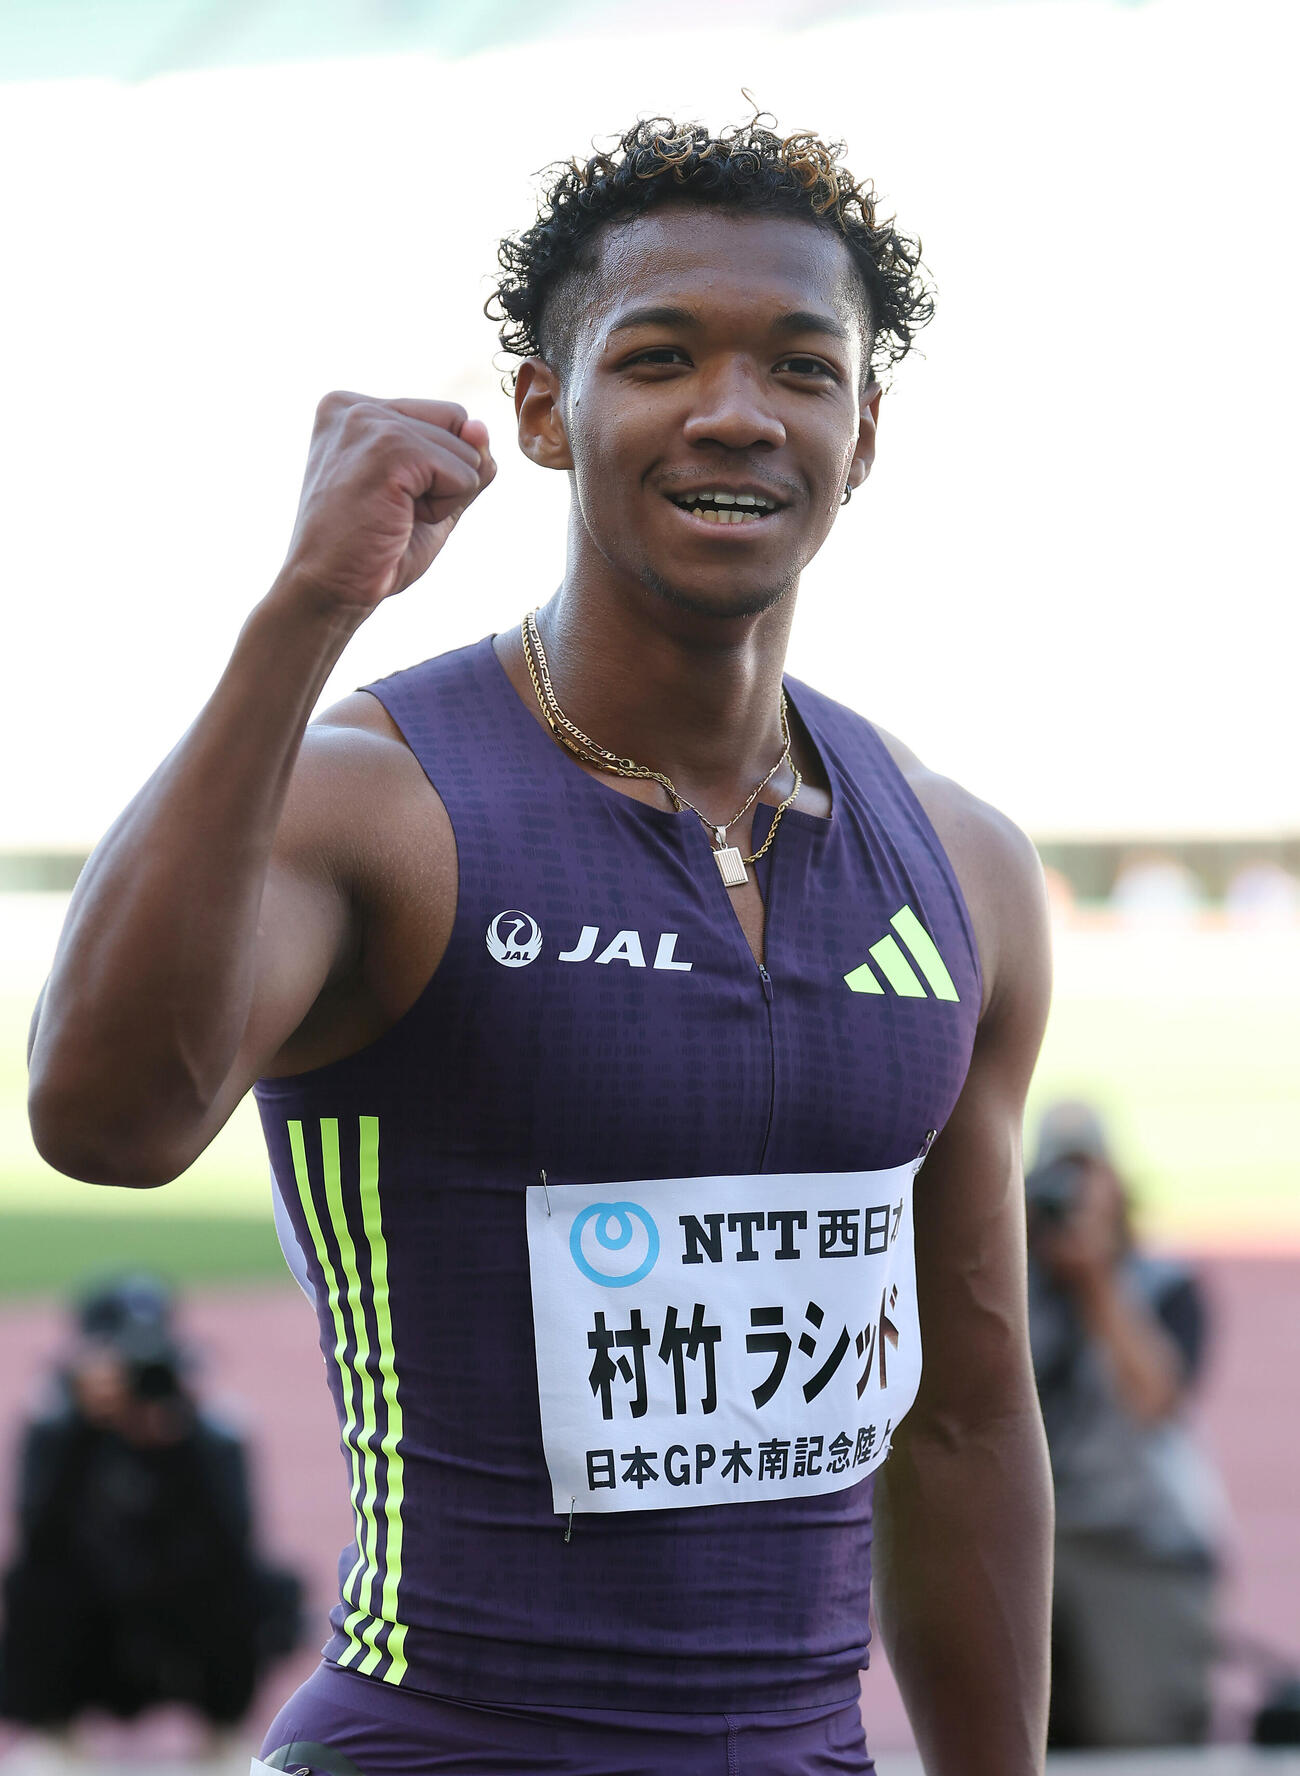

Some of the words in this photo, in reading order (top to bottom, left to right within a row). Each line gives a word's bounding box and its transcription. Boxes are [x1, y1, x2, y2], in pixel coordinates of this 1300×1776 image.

[500, 950, 532, 961] JAL
[557, 925, 694, 972] JAL
[678, 1210, 808, 1265] NTT
[586, 1303, 722, 1421] 村竹
[745, 1283, 900, 1410] ラシッド
